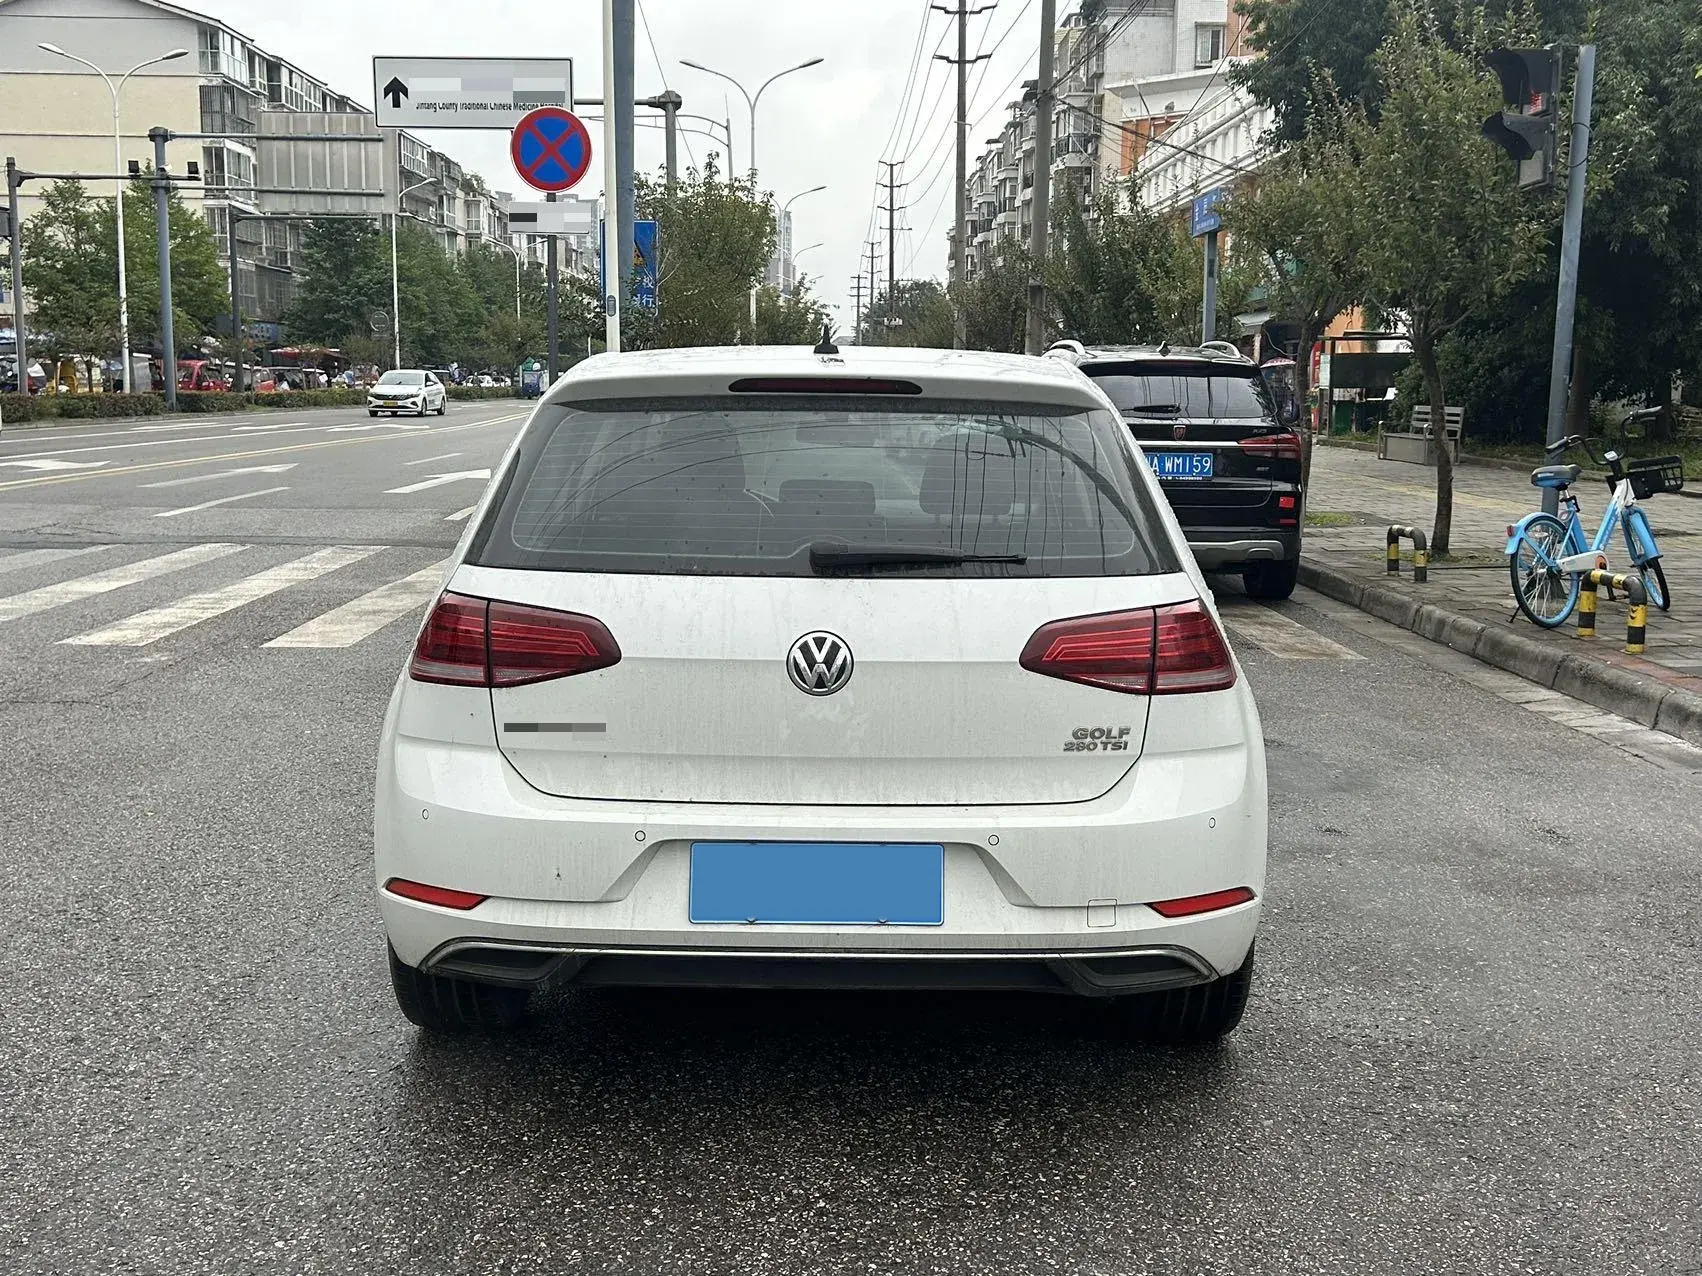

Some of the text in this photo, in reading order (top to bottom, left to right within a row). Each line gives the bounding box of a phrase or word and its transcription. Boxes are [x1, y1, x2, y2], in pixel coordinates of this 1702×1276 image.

[790, 633, 850, 692] VW
[1072, 727, 1132, 740] GOLF
[1063, 741, 1098, 752] 280
